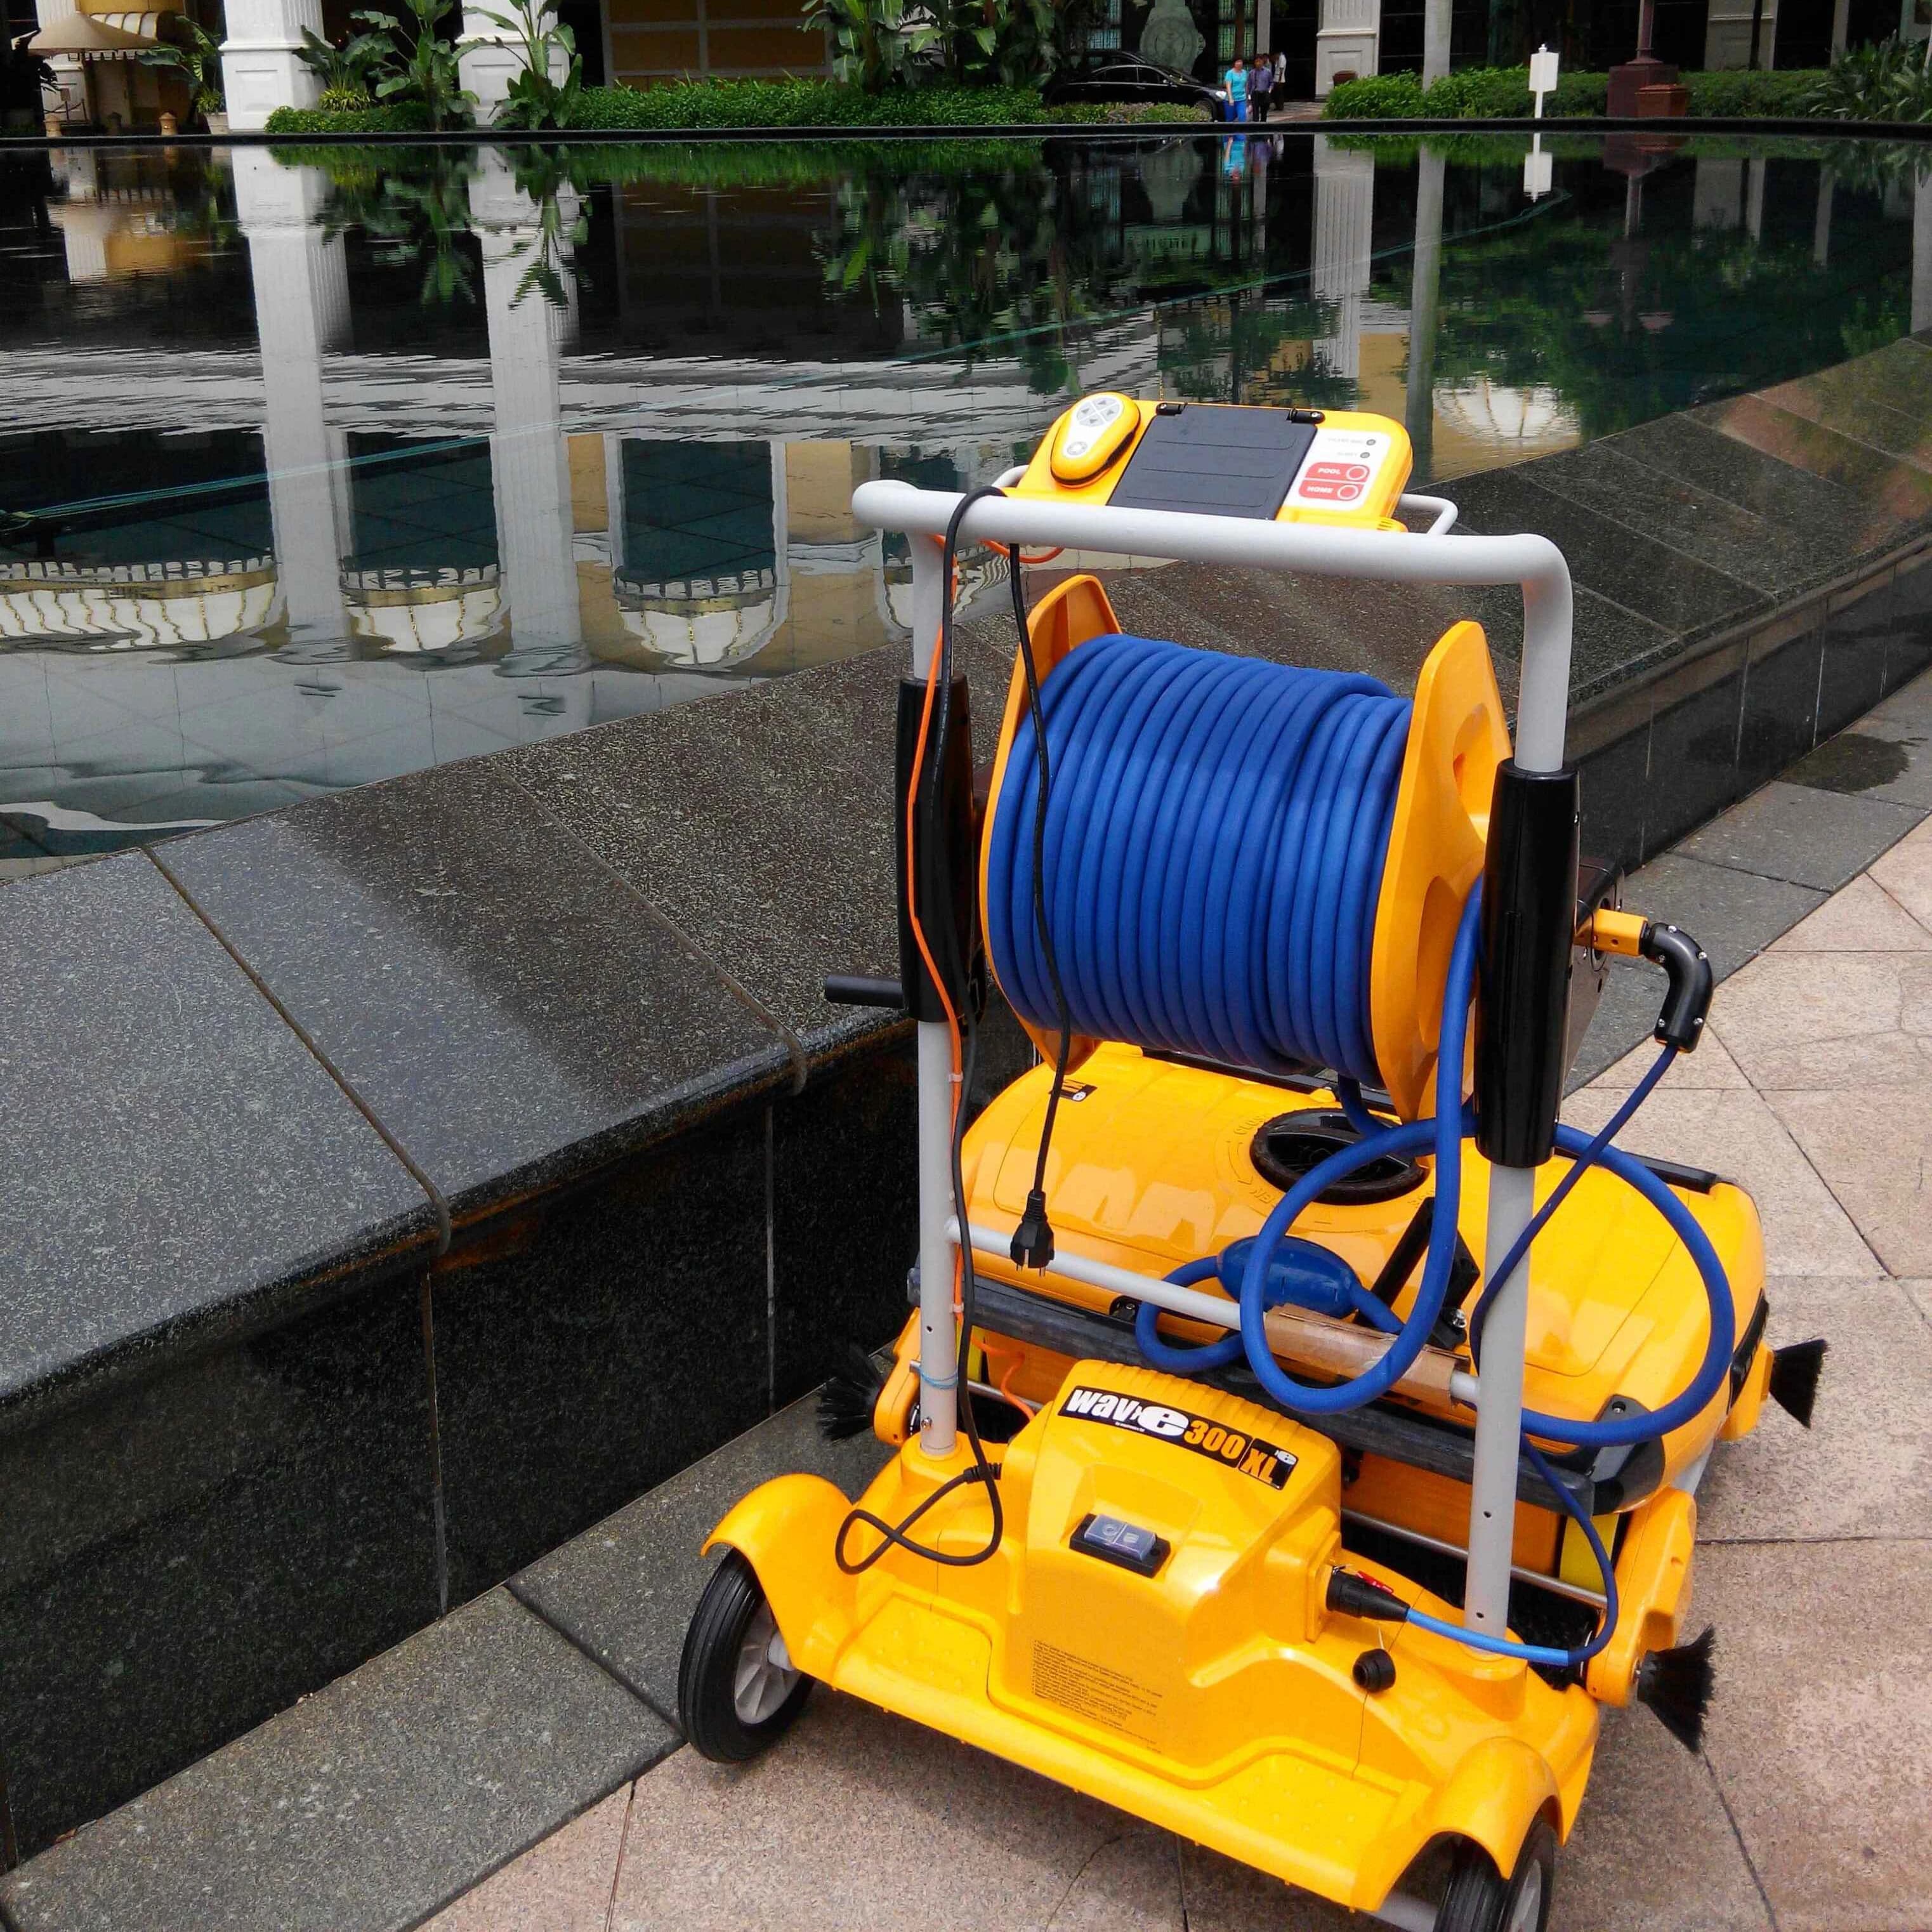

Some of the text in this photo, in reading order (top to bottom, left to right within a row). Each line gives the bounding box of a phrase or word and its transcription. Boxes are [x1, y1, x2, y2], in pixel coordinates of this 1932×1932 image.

[1065, 1388, 1279, 1483] wave 300 XL
